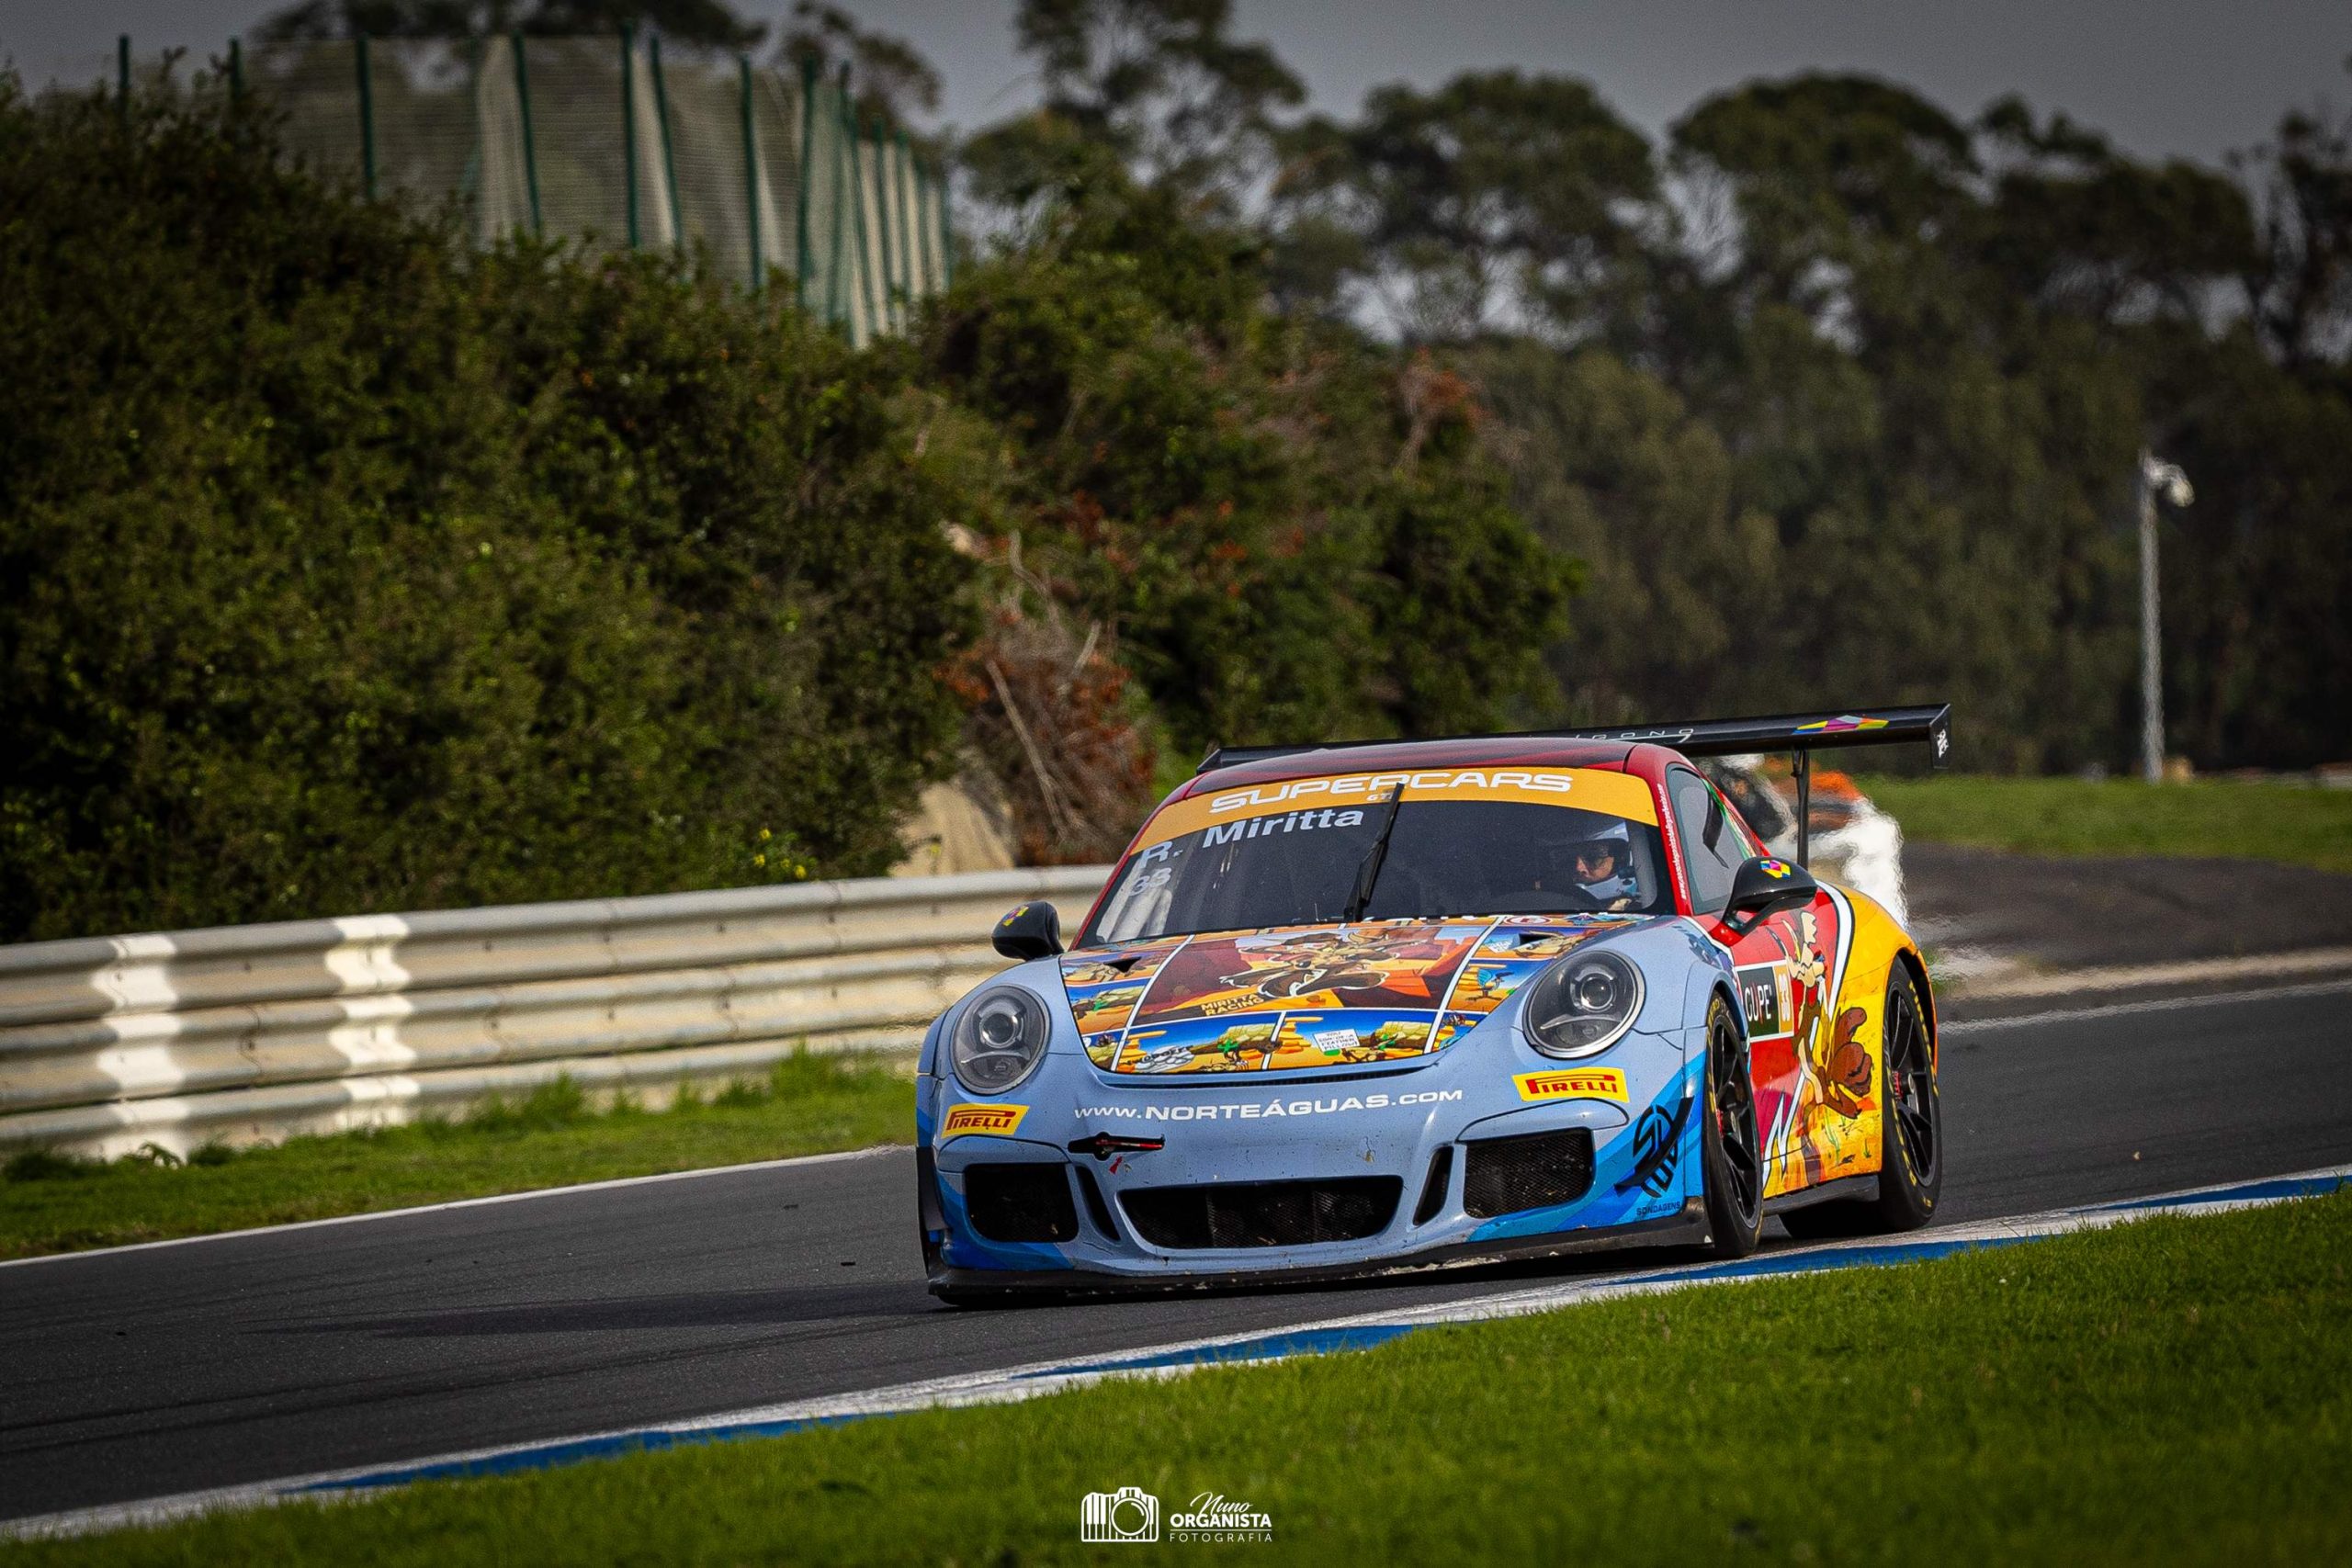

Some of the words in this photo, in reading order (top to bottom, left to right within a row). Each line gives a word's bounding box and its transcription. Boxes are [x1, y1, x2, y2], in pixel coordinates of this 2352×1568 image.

[1208, 772, 1574, 813] SUPERCARS
[1139, 840, 1183, 869] R.
[1202, 809, 1364, 848] Miritta
[1201, 994, 1259, 1010] MIRITTA
[1204, 998, 1264, 1016] RACING
[1525, 1073, 1618, 1095] PIRELLI
[945, 1109, 1017, 1131] PIRELLI
